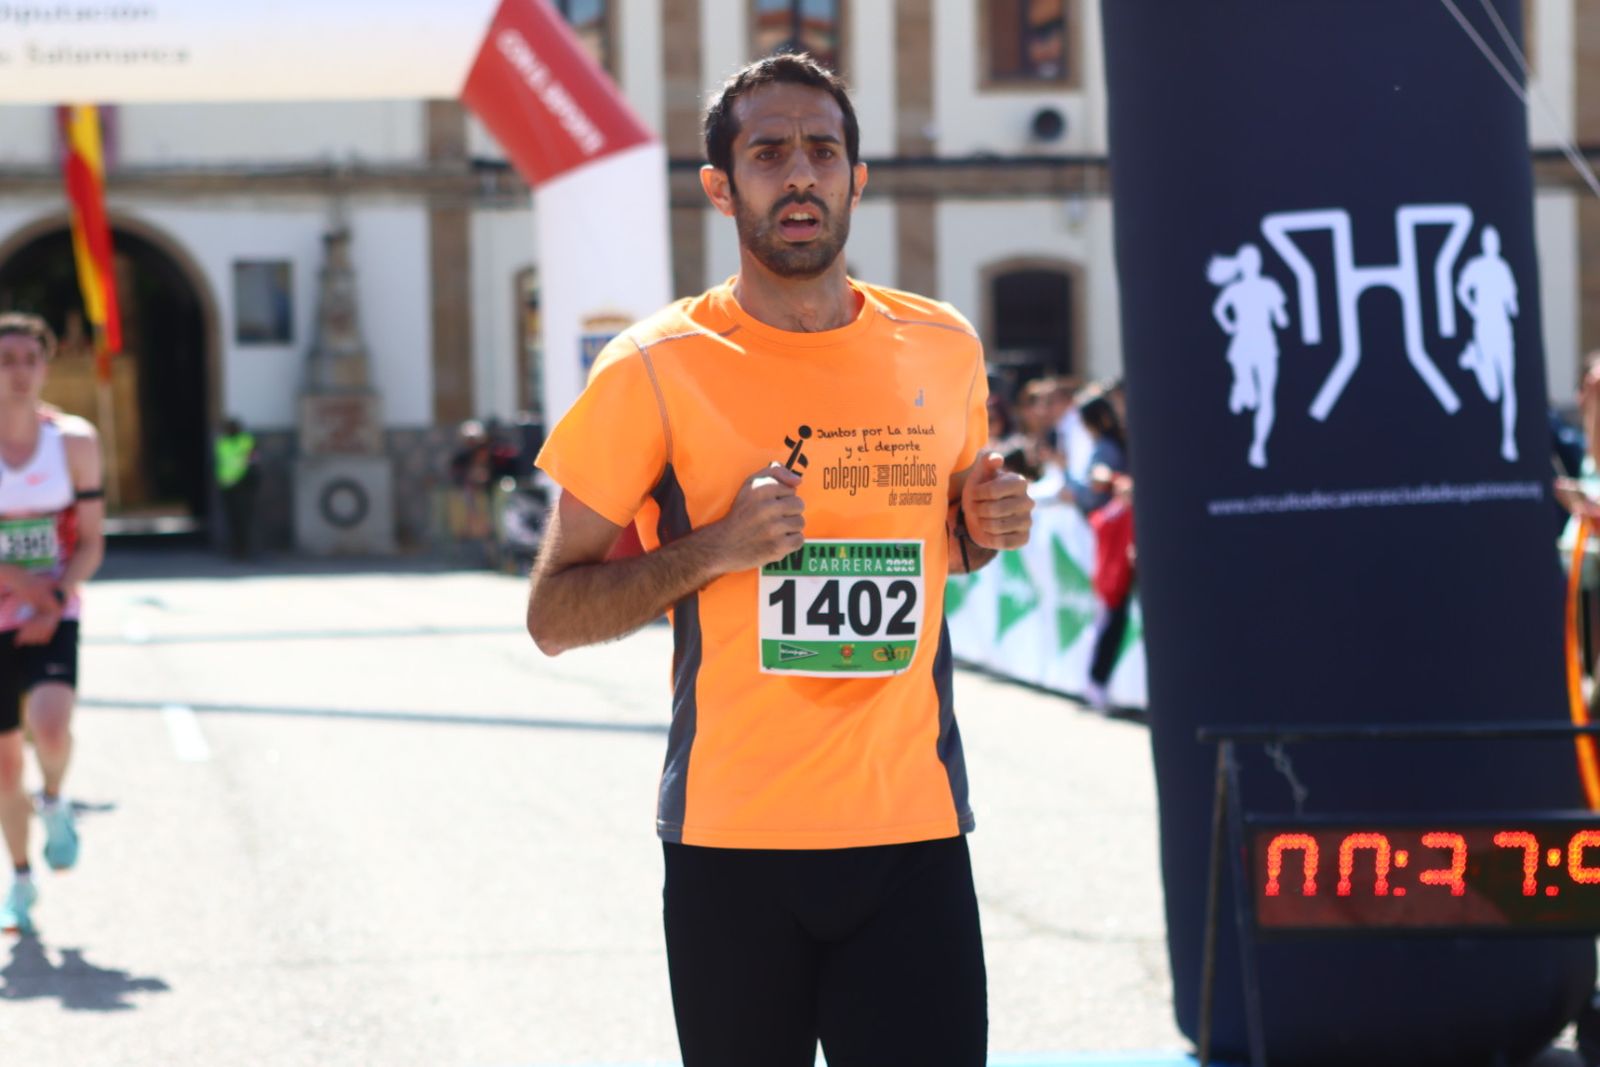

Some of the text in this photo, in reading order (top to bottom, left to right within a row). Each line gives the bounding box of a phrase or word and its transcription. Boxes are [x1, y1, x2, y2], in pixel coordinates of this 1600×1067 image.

[25, 39, 191, 65] Salamanca
[862, 428, 882, 443] por
[907, 425, 936, 435] salud
[845, 441, 921, 459] y el deporte
[823, 457, 869, 496] colegio
[891, 456, 937, 488] médicos
[888, 490, 897, 506] de
[809, 546, 836, 559] SAN
[809, 558, 882, 572] CARRERA
[769, 579, 917, 636] 1402
